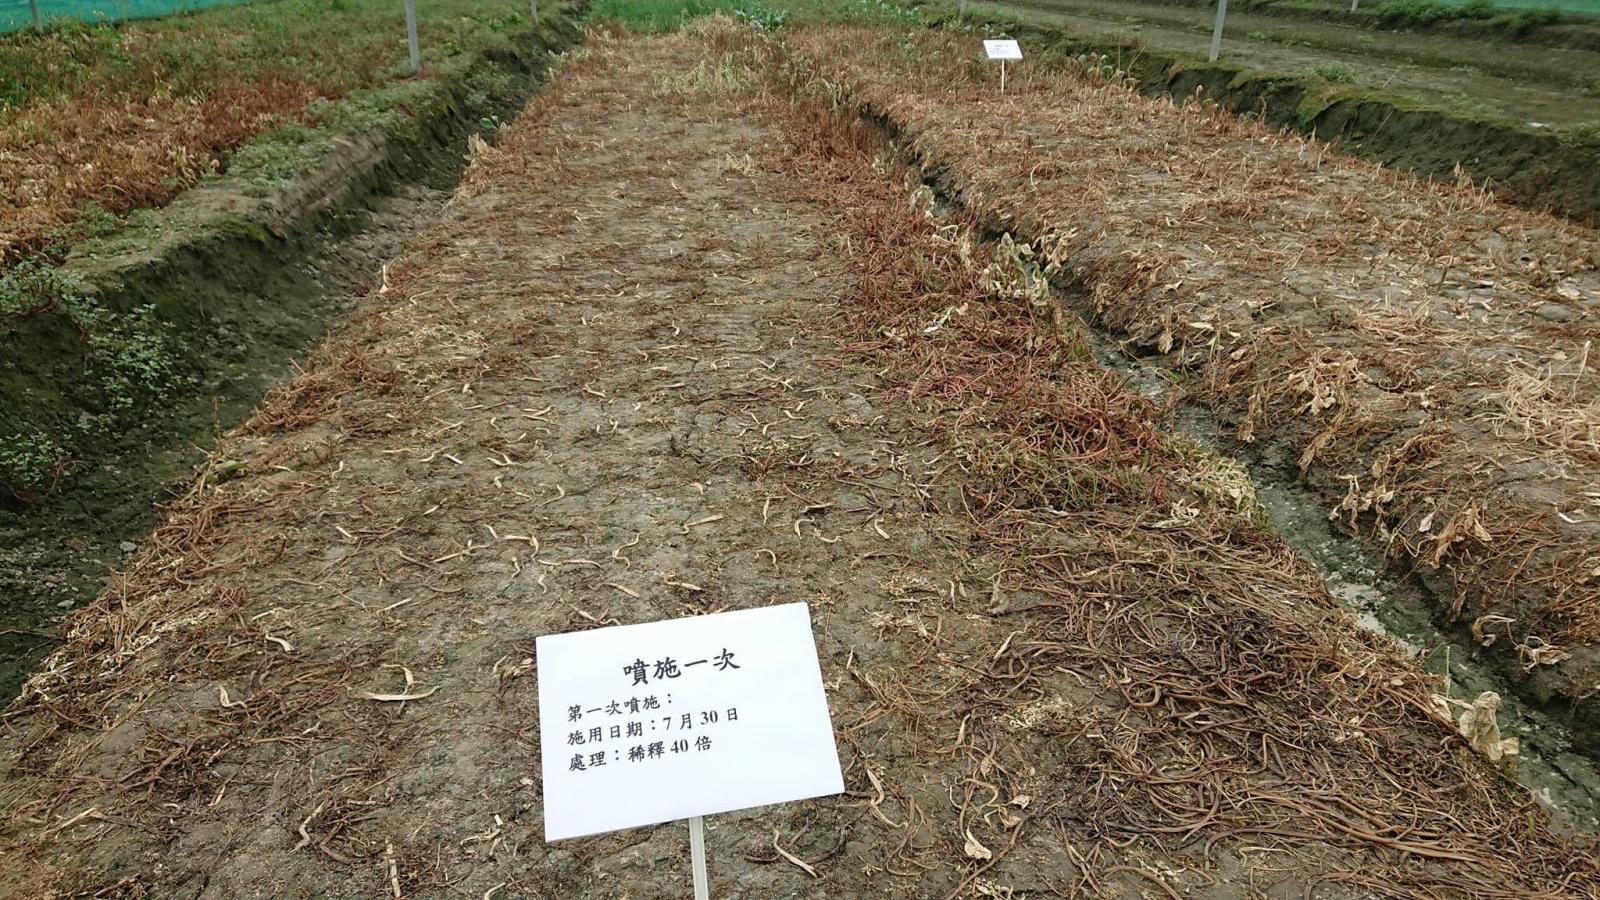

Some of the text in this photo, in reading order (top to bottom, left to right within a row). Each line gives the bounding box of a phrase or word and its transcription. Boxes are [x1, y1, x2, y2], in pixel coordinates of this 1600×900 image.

[622, 647, 741, 687] 噴施一次
[567, 693, 673, 723] 第一次噴施：
